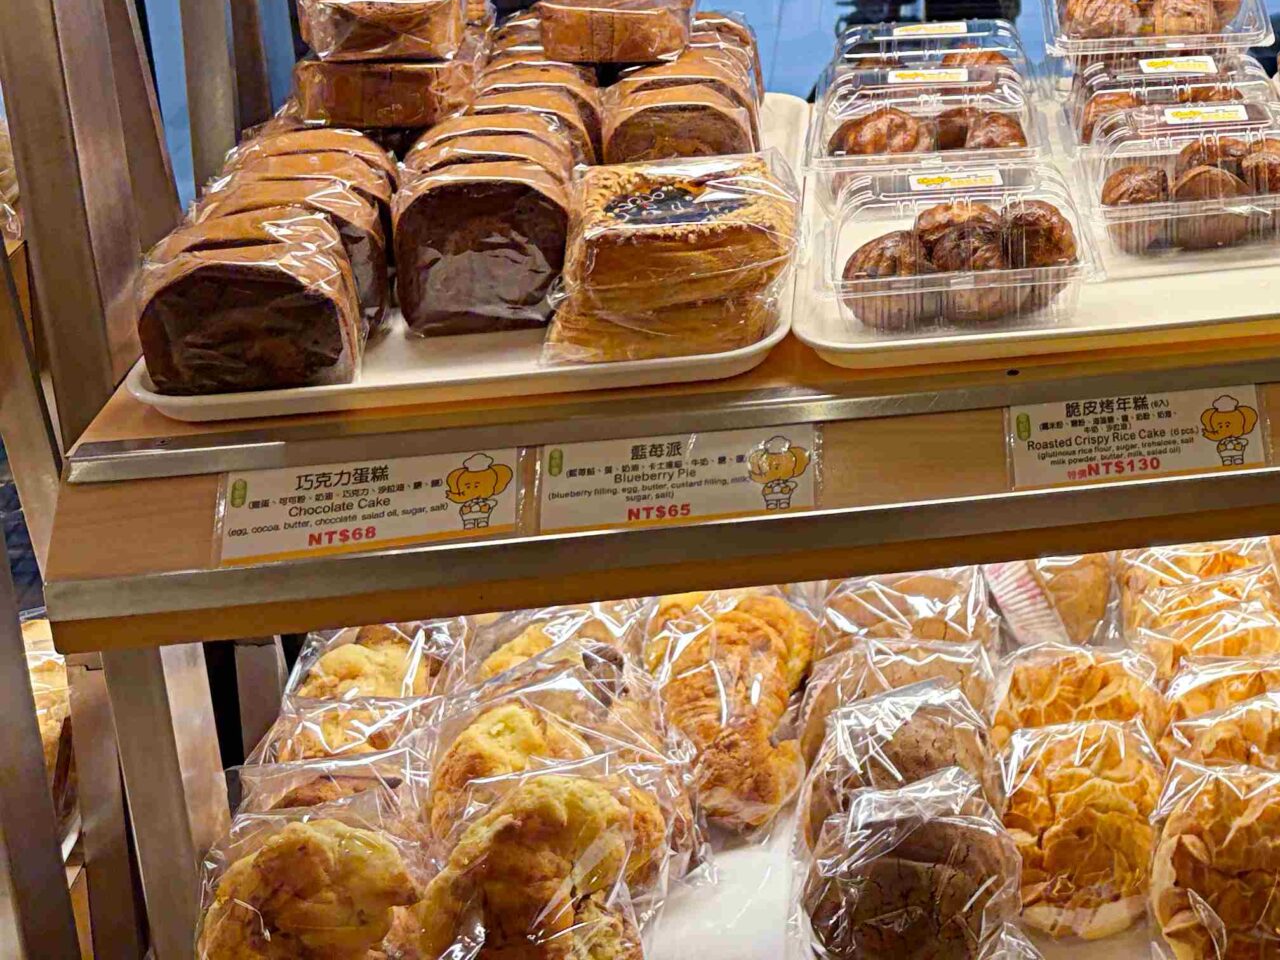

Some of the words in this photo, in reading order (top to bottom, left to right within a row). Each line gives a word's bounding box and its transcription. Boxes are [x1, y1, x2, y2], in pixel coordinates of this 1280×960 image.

[1027, 437, 1072, 451] Roasted
[1074, 435, 1110, 447] Crispy
[1112, 431, 1136, 442] Rice
[1138, 428, 1166, 440] Cake
[631, 441, 682, 461] 藍莓派
[295, 464, 389, 491] 巧克力蛋糕
[614, 470, 674, 484] Blueberry
[678, 468, 697, 479] Pie
[289, 501, 354, 518] Chocolate
[357, 496, 391, 510] Cake
[628, 503, 691, 521] NT$65
[308, 526, 377, 547] NT$68
